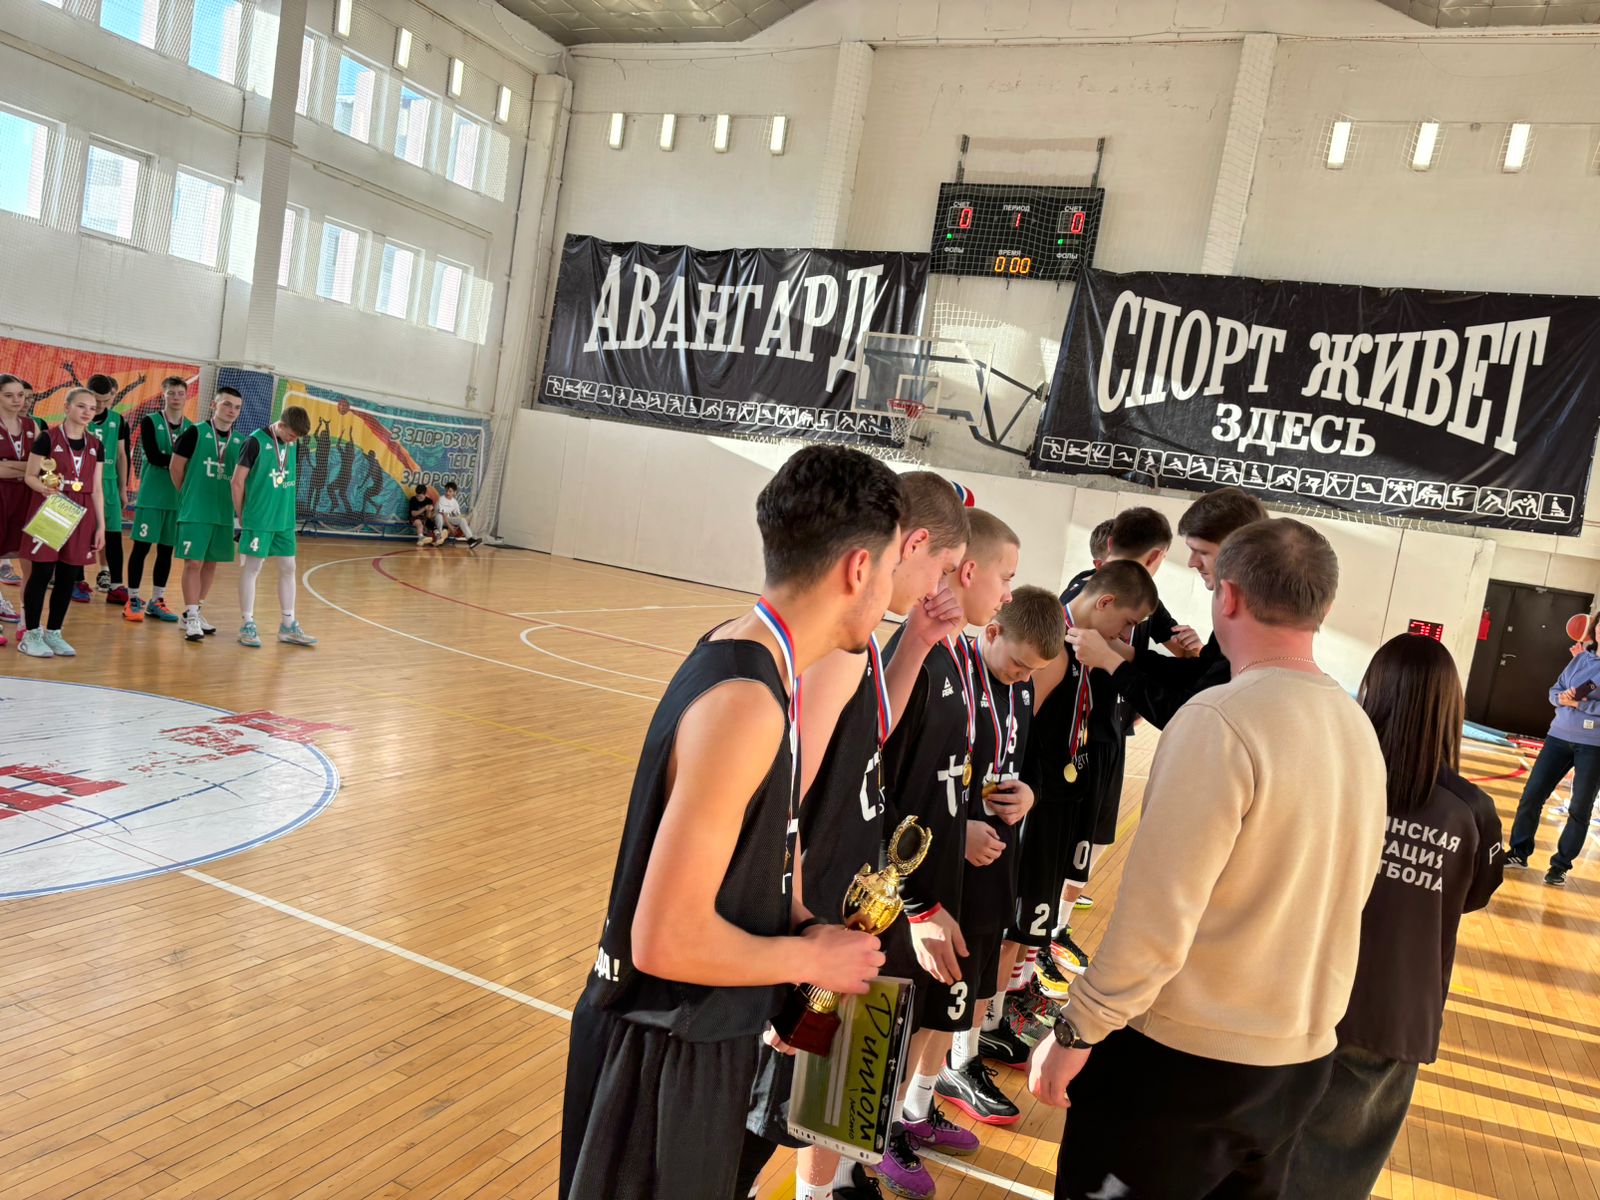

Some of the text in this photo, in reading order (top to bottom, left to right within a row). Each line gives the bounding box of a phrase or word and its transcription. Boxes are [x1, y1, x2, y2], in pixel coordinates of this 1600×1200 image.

[959, 208, 973, 228] 0
[1003, 204, 1030, 213] ПЕРИОД
[1071, 211, 1085, 234] 0
[1056, 252, 1079, 260] ФОЛЫ
[582, 254, 885, 400] АВАНГАРД
[1097, 289, 1551, 456] СПОРТ ЖИВЕТ
[1211, 403, 1377, 457] ЗДЕСЬ
[140, 523, 148, 537] 3
[183, 541, 192, 555] 7
[250, 537, 259, 551] 4
[1073, 840, 1090, 870] 0
[1029, 903, 1050, 936] 2
[947, 981, 968, 1020] 3
